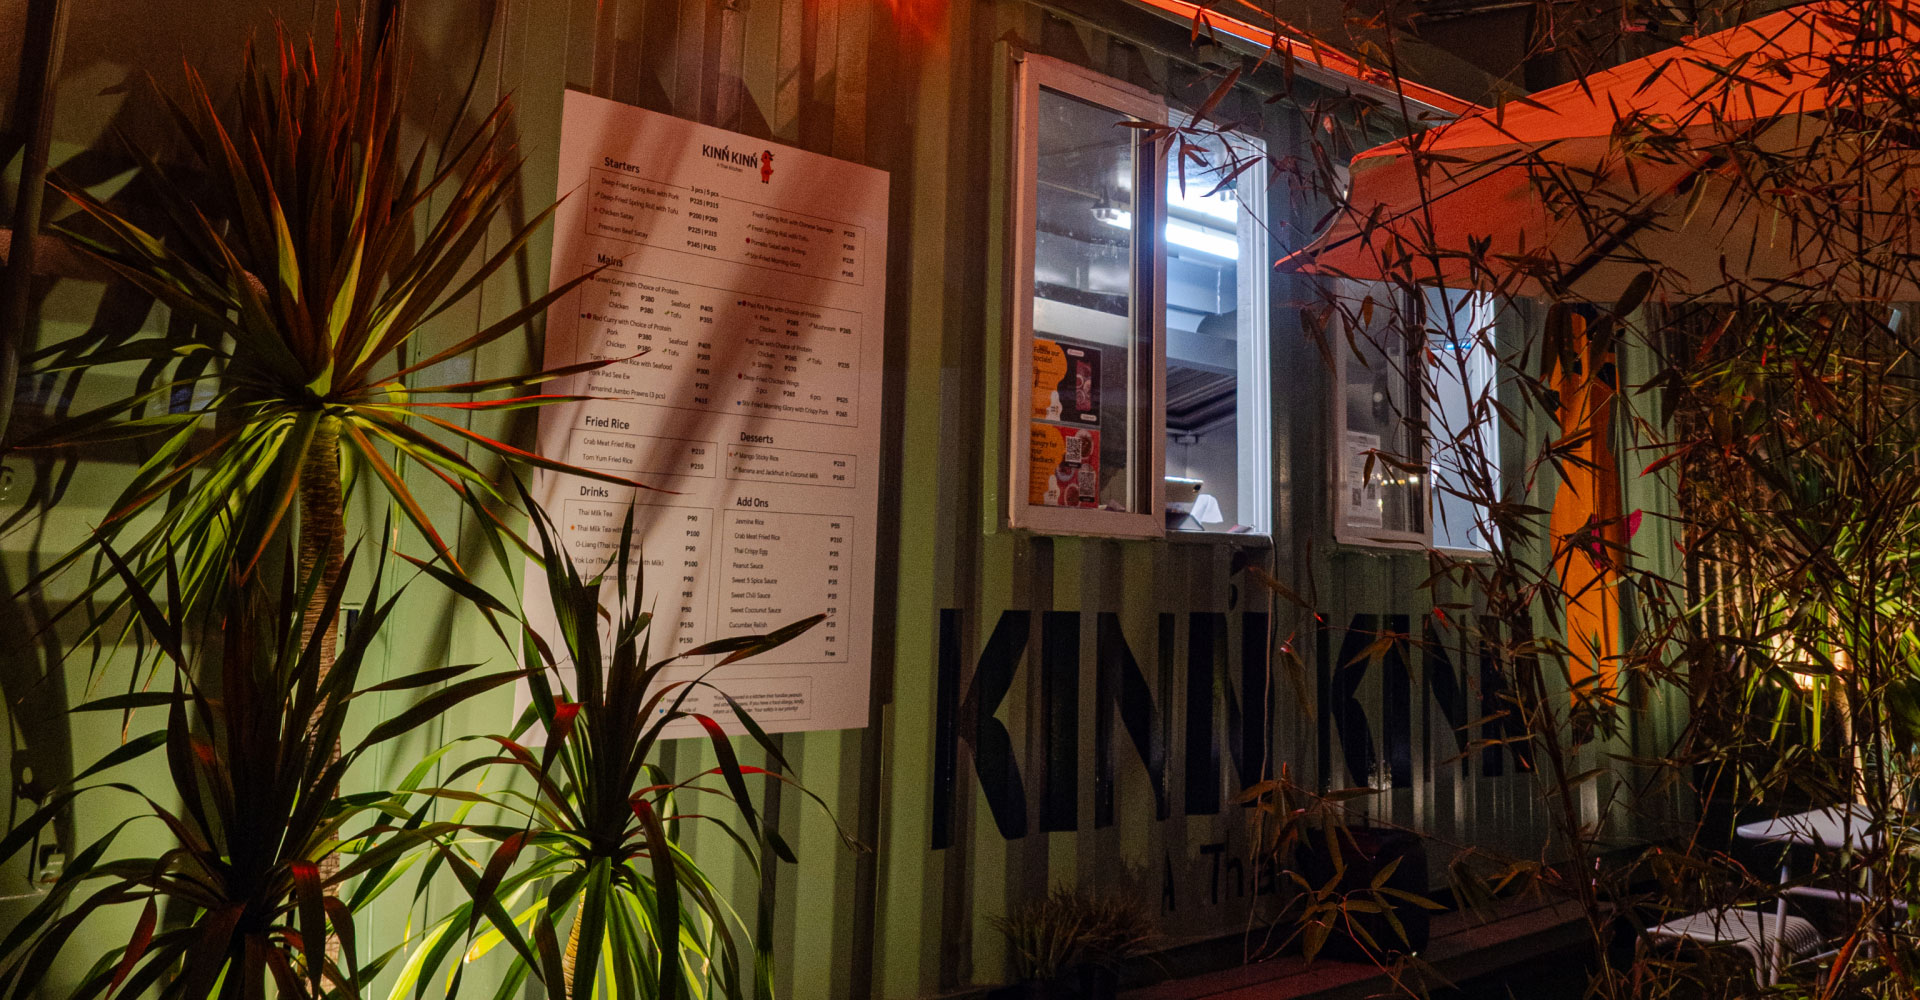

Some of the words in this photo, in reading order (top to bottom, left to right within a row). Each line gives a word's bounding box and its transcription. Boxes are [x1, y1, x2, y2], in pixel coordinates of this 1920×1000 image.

[605, 157, 640, 174] Starters
[599, 208, 619, 218] Chicken
[598, 254, 623, 267] Mains
[612, 278, 625, 288] Curry
[638, 283, 654, 291] Choice
[662, 286, 679, 295] Protein
[609, 301, 629, 310] Chicken
[671, 311, 681, 319] Tofu
[671, 300, 690, 309] Seafood
[604, 316, 617, 324] Curry
[630, 320, 646, 328] Choice
[654, 324, 671, 332] Protein
[607, 328, 618, 336] Pork
[669, 338, 688, 346] Seafood
[606, 340, 626, 348] Chicken
[668, 348, 679, 356] Tofu
[629, 358, 639, 366] Rice
[653, 362, 672, 371] Seafood
[588, 384, 612, 393] Tamarind
[613, 387, 630, 395] Jumbo
[631, 389, 648, 397] Prawns
[783, 404, 794, 413] Glory
[805, 407, 818, 416] Crispy
[586, 416, 608, 427] Fried
[611, 418, 629, 430] Rice
[584, 437, 595, 445] Crab
[597, 439, 609, 447] Meat
[611, 440, 623, 448] Fried
[741, 432, 774, 444] Desserts
[580, 486, 608, 498] Drinks
[737, 497, 752, 507] Add
[754, 498, 768, 508] Ons
[591, 509, 601, 517] Milk
[576, 541, 596, 549] O-Liang
[745, 548, 758, 556] Crispy
